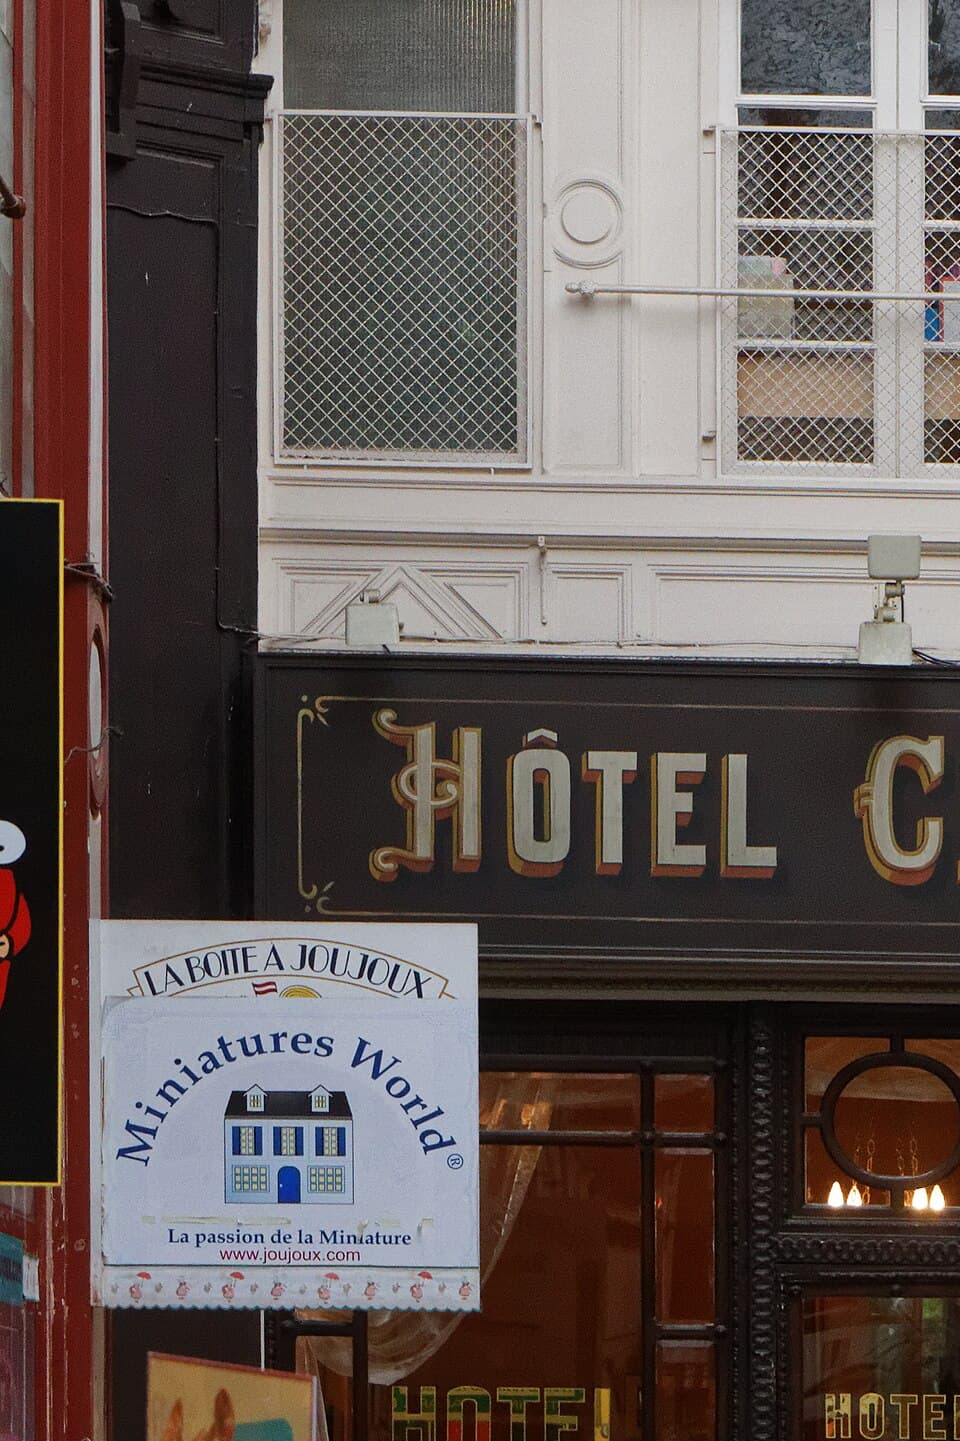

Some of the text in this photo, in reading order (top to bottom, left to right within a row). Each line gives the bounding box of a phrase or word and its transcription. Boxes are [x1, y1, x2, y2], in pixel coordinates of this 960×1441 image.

[143, 964, 185, 997] LA
[184, 946, 259, 984] BOITE
[290, 943, 432, 999] JOUJOUX
[115, 1029, 457, 1167] Miniatures World
[167, 1228, 190, 1245] La
[194, 1228, 266, 1248] passion
[270, 1228, 293, 1245] de
[298, 1228, 314, 1245] la
[219, 1247, 361, 1264] www.joujoux.com
